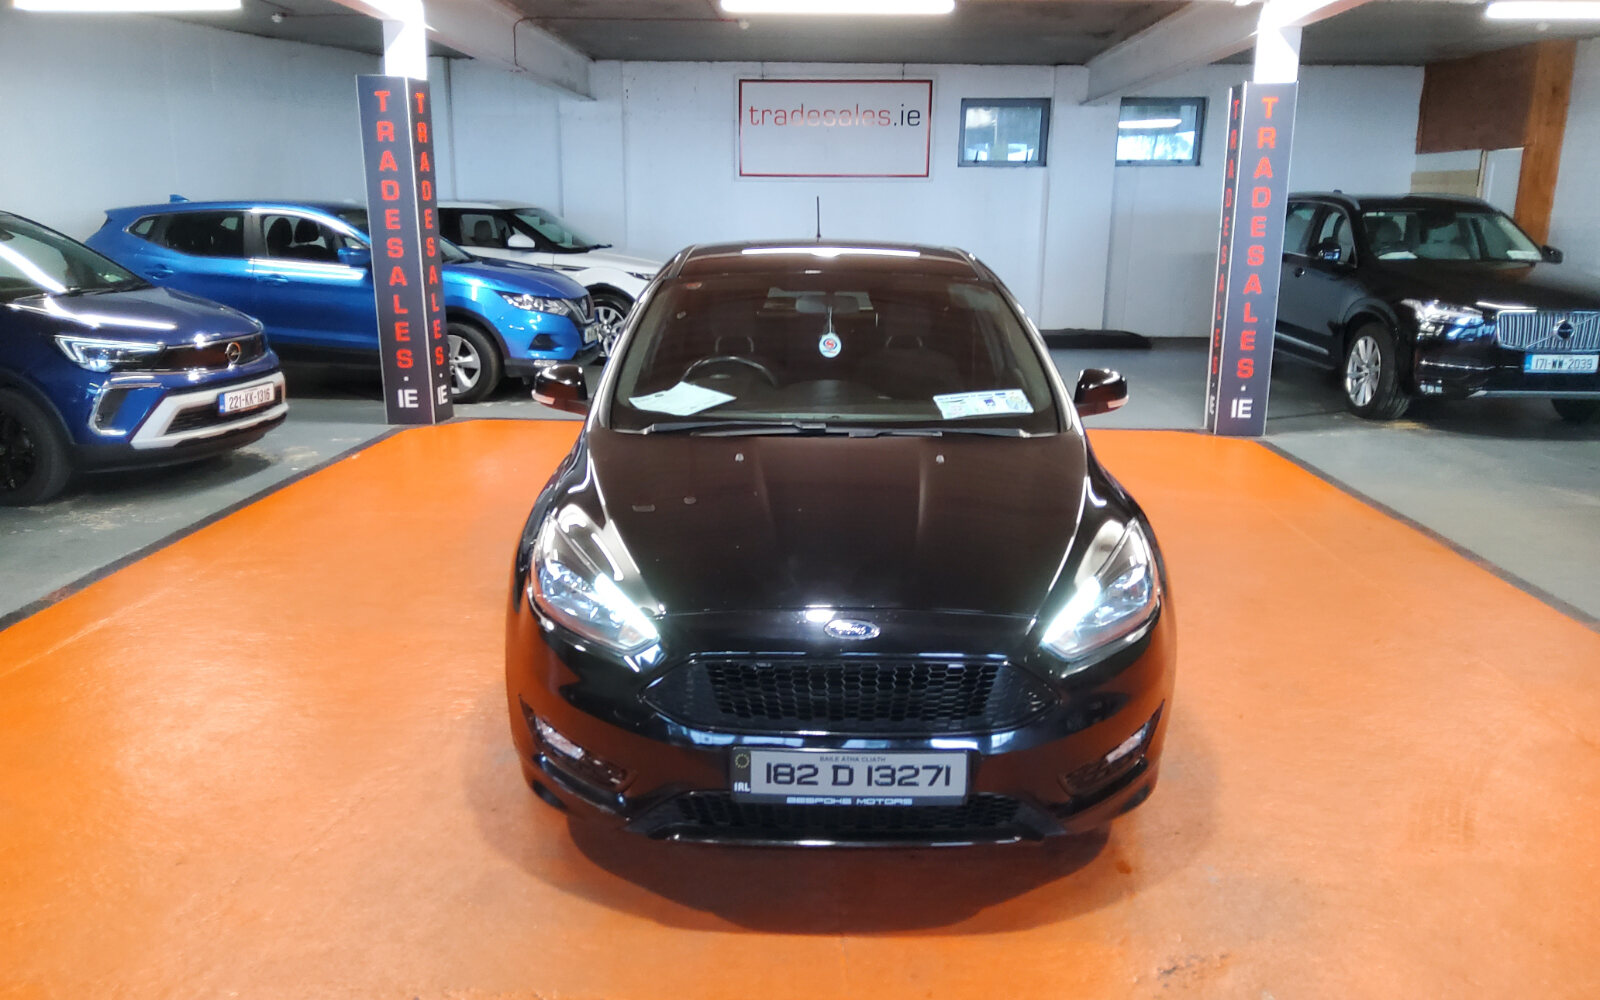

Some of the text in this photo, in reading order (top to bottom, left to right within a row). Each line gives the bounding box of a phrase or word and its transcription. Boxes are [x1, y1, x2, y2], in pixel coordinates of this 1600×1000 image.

[749, 103, 921, 126] tradesales.ie
[766, 762, 951, 787] 182 D 13271
[734, 782, 751, 792] IRL
